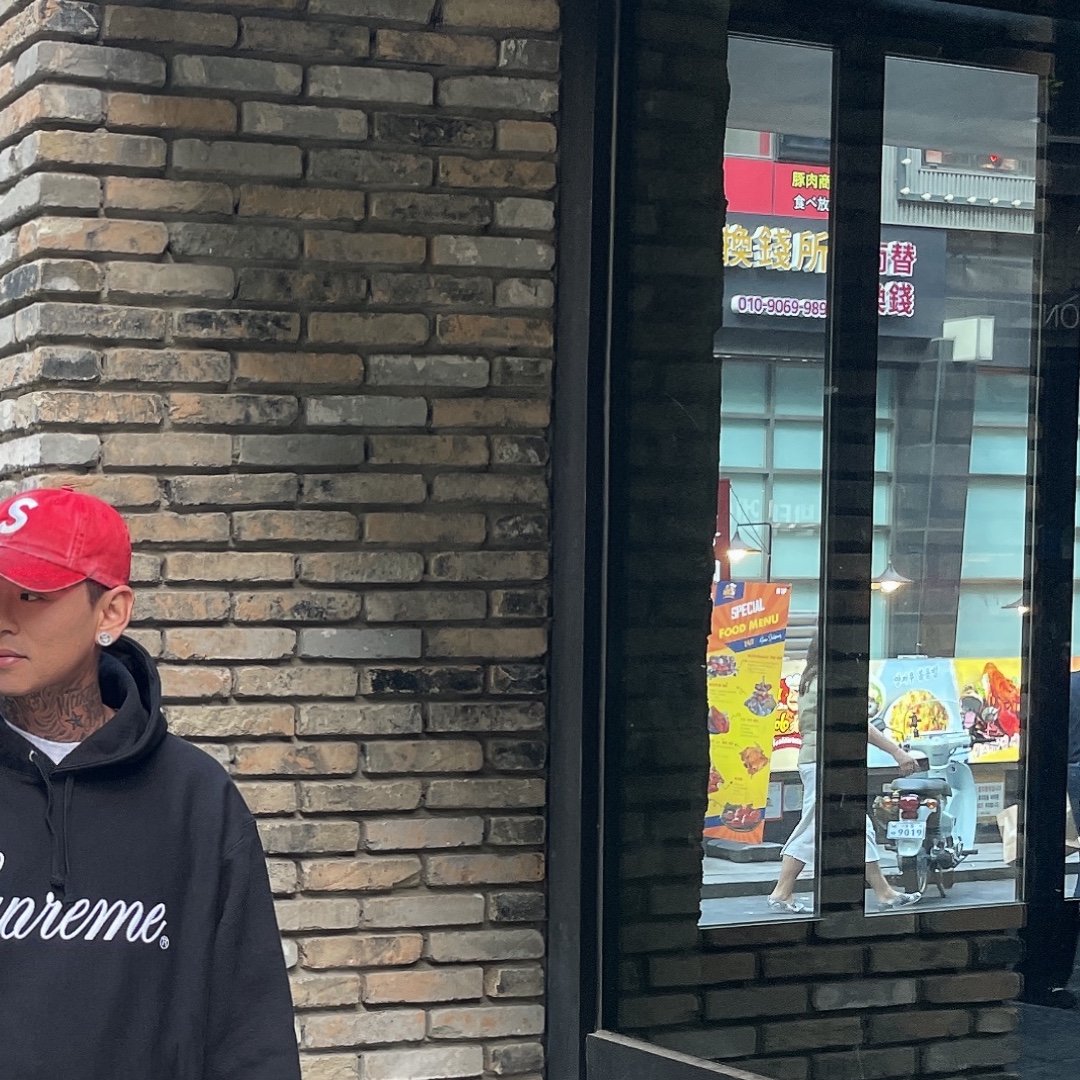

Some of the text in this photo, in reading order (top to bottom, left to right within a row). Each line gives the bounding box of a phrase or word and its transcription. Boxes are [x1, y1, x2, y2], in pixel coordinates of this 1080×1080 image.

[723, 224, 828, 273] 換錢所
[731, 598, 765, 620] SPECIAL
[718, 623, 746, 639] FOOD
[749, 613, 779, 631] MENU
[897, 828, 923, 837] 9019
